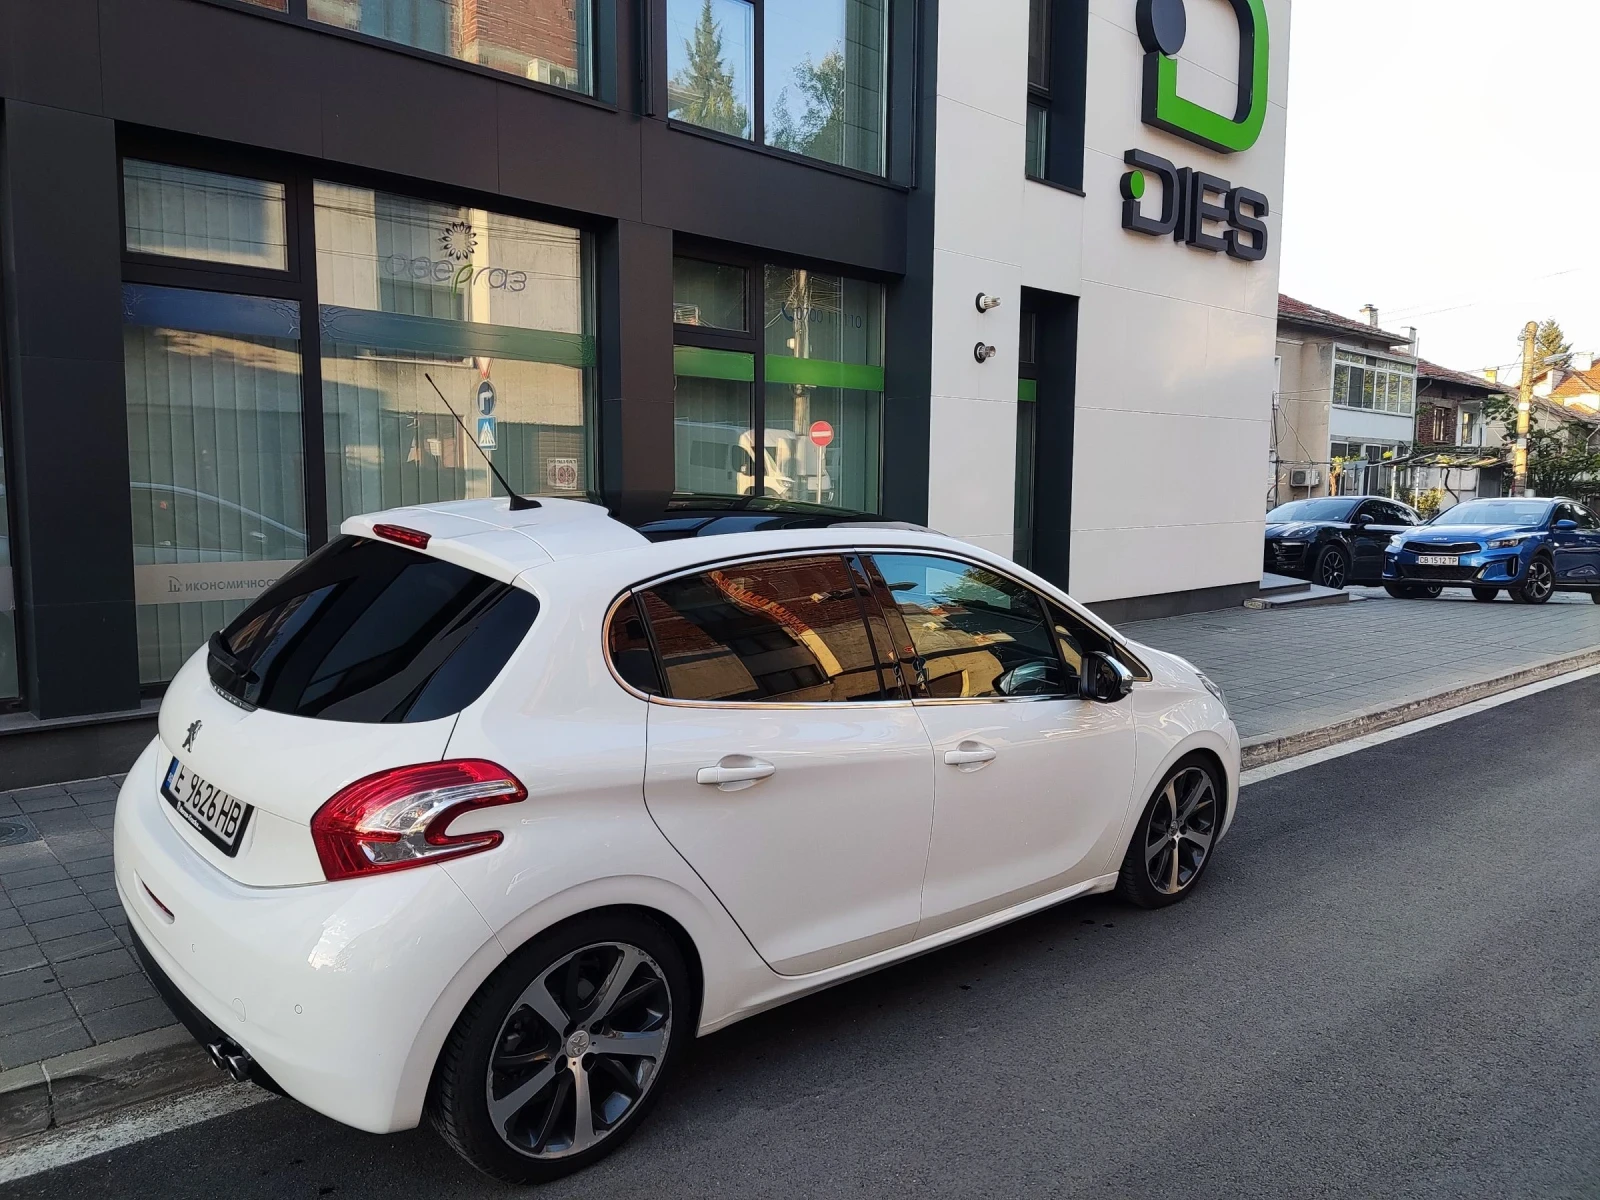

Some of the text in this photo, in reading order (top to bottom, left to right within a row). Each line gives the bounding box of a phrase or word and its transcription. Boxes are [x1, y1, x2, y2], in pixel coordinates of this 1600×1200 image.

[1120, 148, 1269, 262] DIES
[186, 773, 221, 822] 9626
[215, 794, 242, 838] HB
